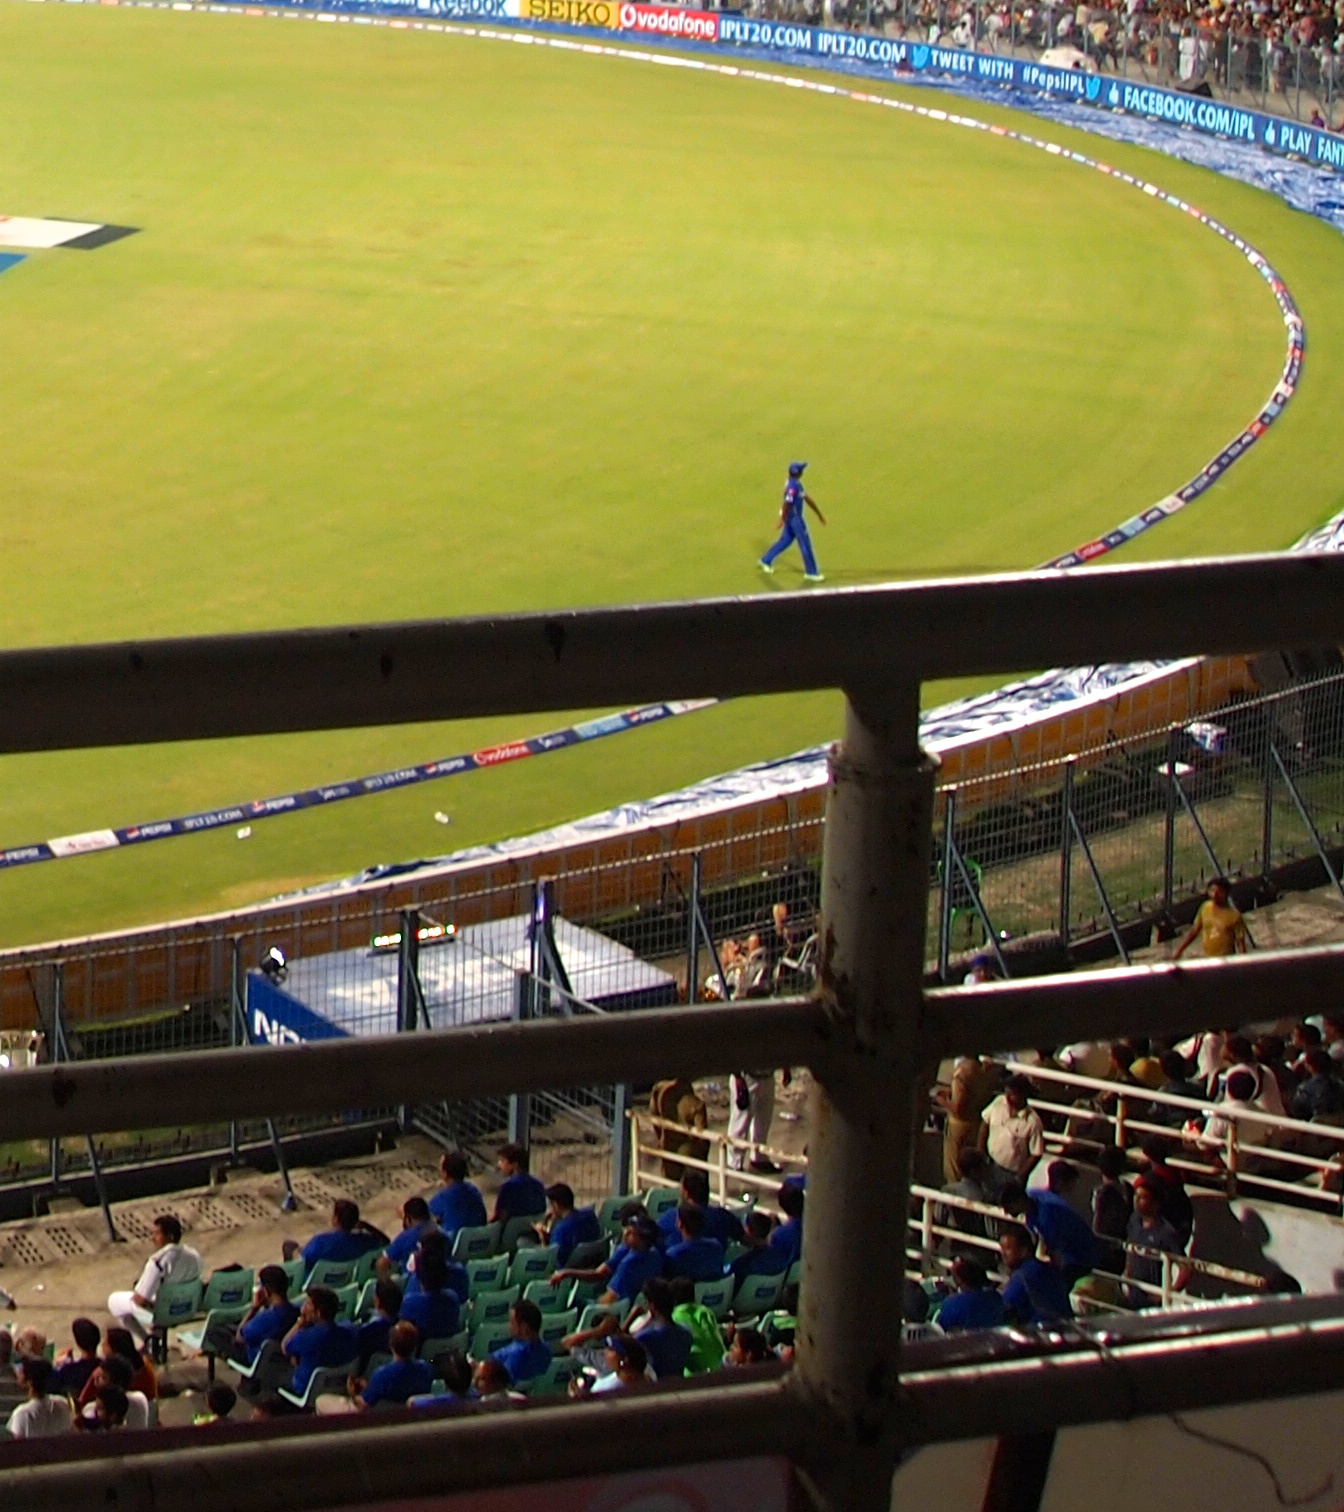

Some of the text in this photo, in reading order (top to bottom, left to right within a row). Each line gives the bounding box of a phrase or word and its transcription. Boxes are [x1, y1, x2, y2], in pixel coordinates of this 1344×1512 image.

[637, 13, 716, 36] vodafone
[719, 19, 811, 49] IPLT20.COM
[817, 33, 907, 63] IPLT20.COM
[931, 49, 1085, 95] TWEET WITH #PepsiIPL
[1123, 85, 1255, 139] FACEBOOK.COM/IPL
[1280, 125, 1312, 156] PLAY
